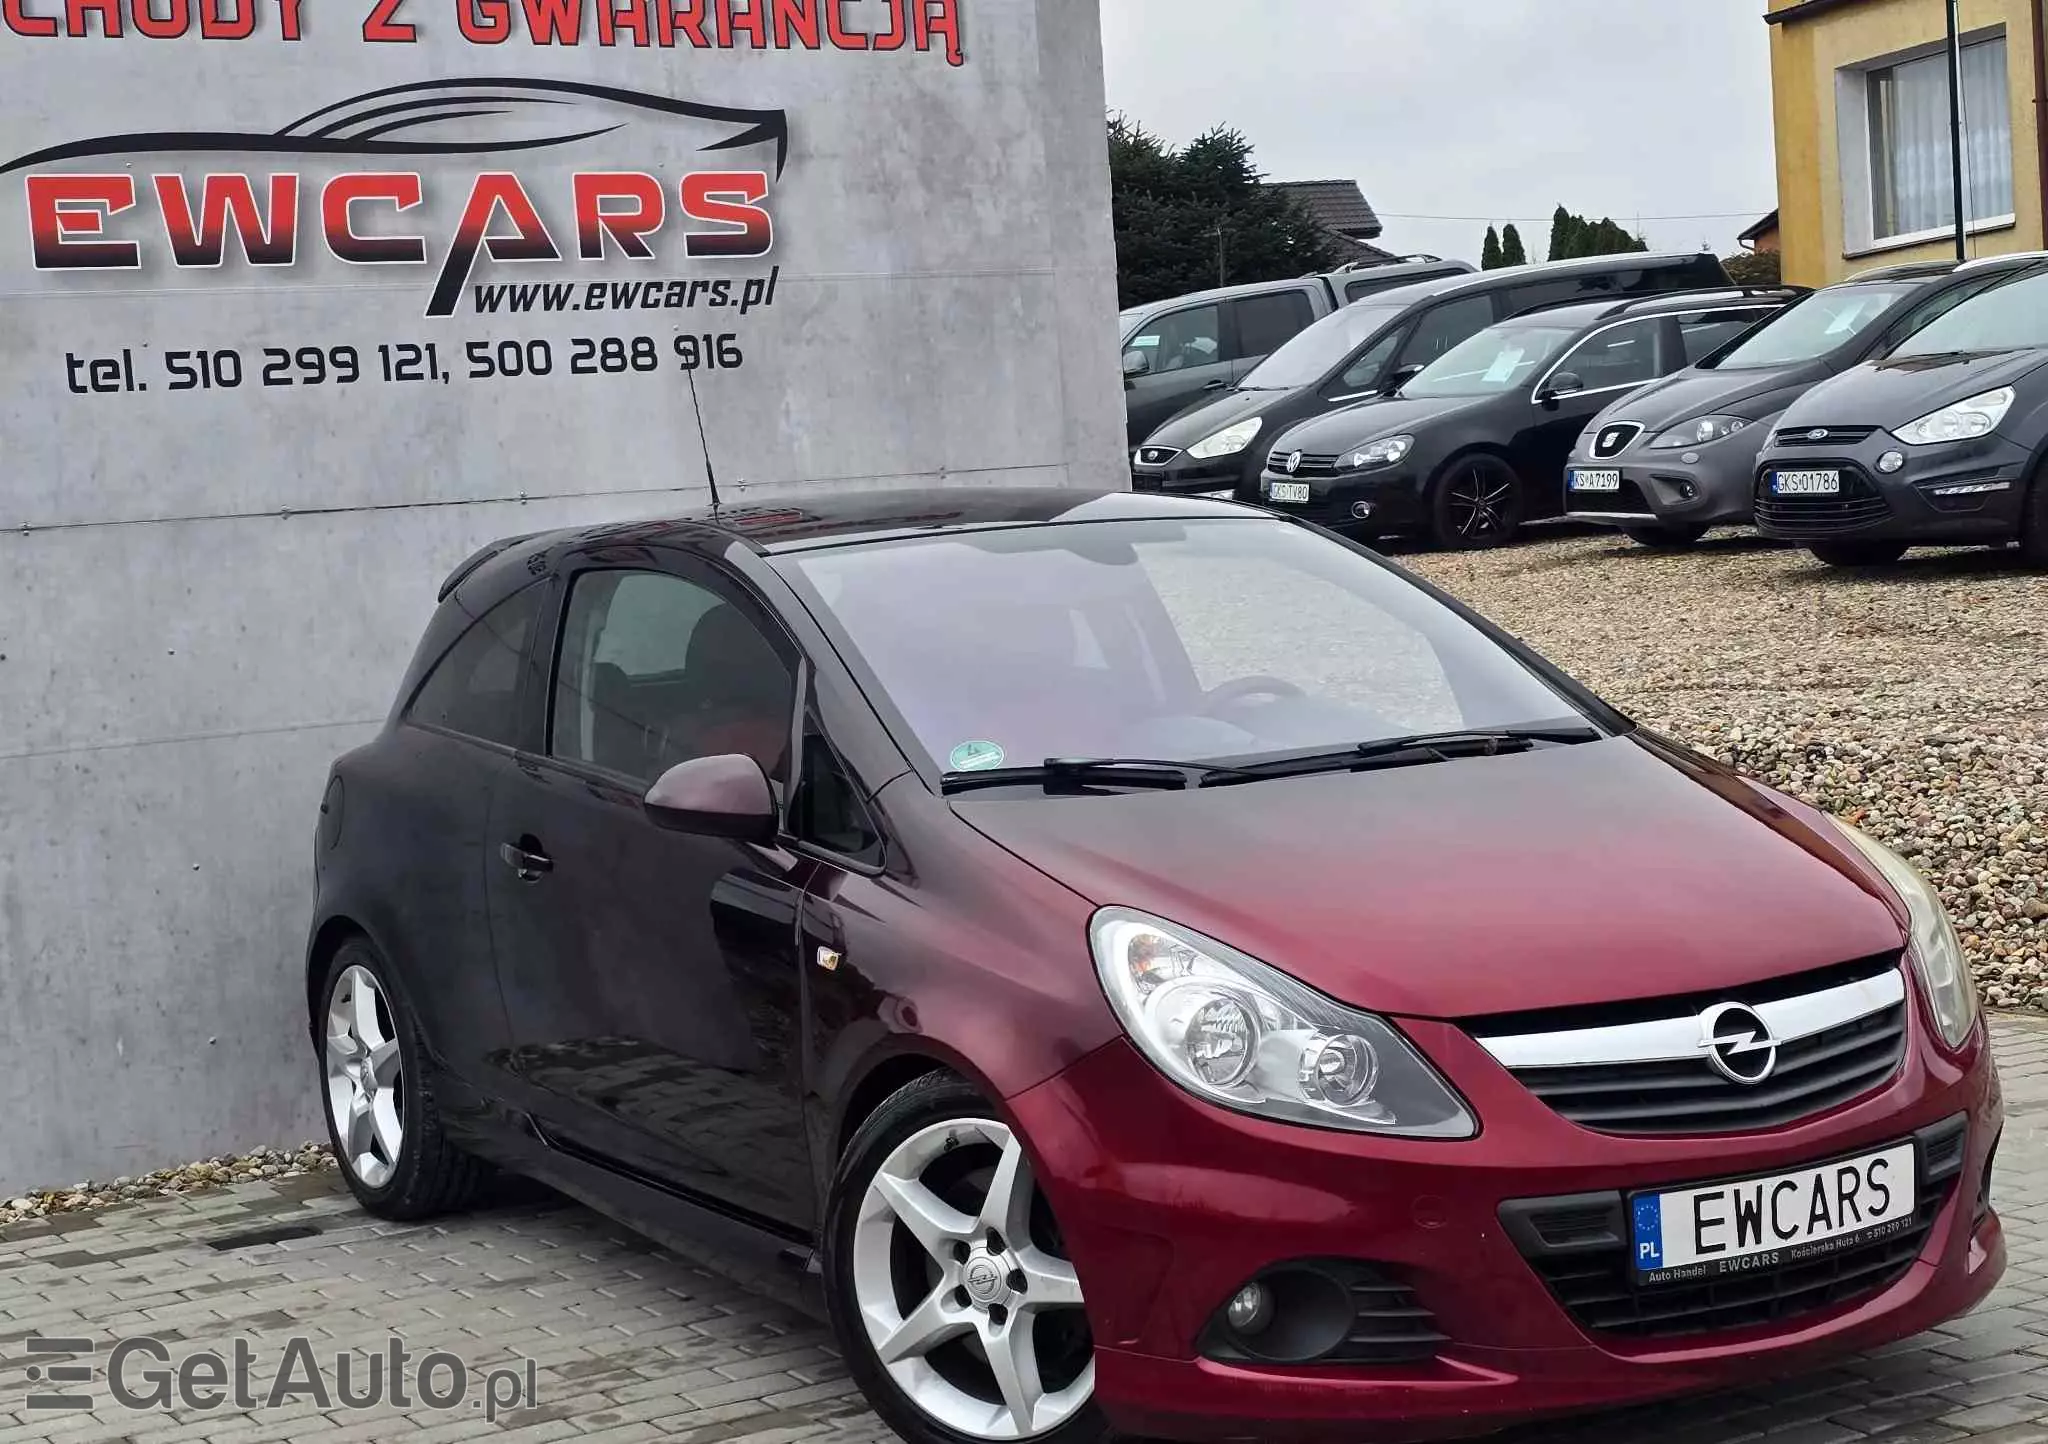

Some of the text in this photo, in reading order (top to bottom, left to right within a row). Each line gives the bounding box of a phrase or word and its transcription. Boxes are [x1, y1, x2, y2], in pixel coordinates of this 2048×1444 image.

[456, 0, 965, 67] GWARANCJĄ
[26, 171, 774, 318] EWCARS
[474, 265, 779, 315] www.ewcars.pl
[65, 333, 744, 394] tel. 510 299 121, 500 288 916
[1801, 472, 1838, 491] 01786
[1693, 1158, 1891, 1255] EWCARS
[1639, 1241, 1661, 1260] PL
[1648, 1269, 1671, 1283] Auto
[1719, 1252, 1780, 1273] EWCARS
